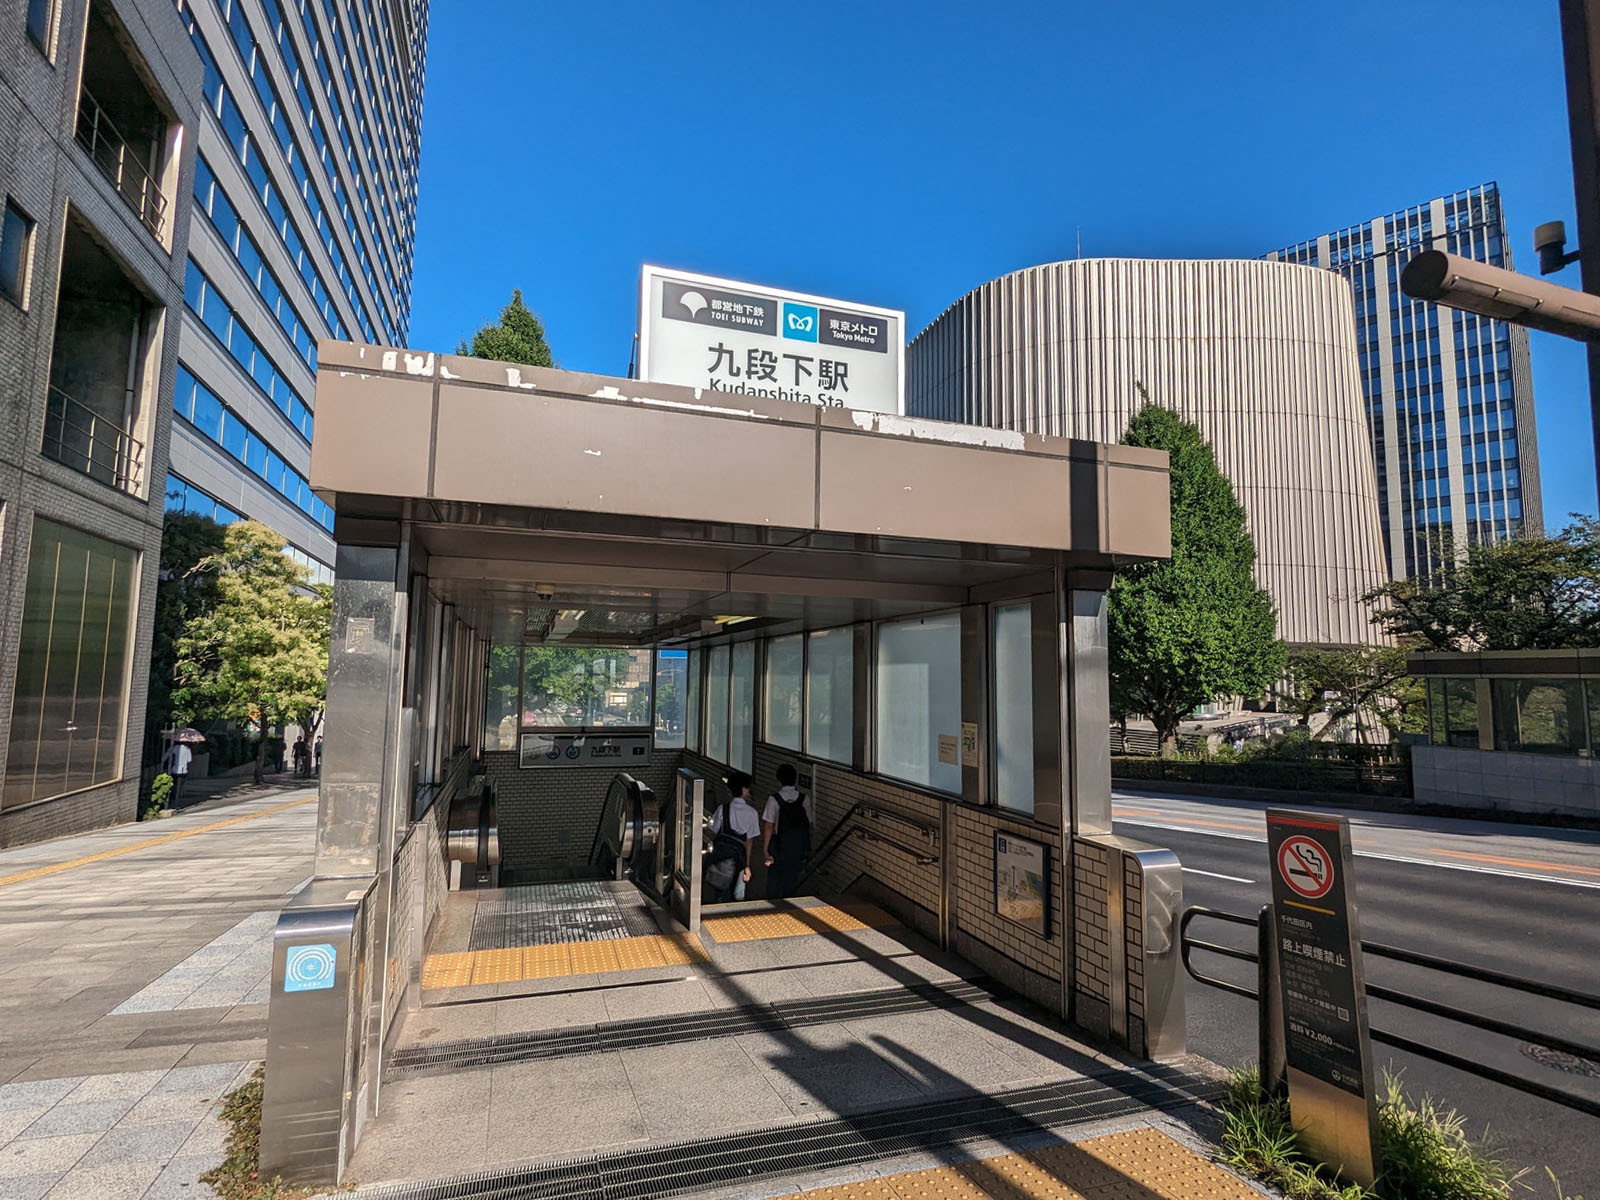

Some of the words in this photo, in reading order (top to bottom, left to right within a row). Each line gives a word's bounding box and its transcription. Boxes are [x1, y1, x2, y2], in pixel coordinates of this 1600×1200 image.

[711, 299, 764, 317] 都営地下鉄
[711, 311, 729, 321] TOEI
[731, 315, 764, 326] SUBWAY
[830, 319, 878, 336] 東京メトロ
[832, 330, 853, 341] Tokyo
[854, 334, 875, 344] Metro
[708, 342, 849, 393] 九段下駅
[1281, 914, 1313, 930] 千代田区内
[1282, 938, 1347, 968] 路上喫煙禁止
